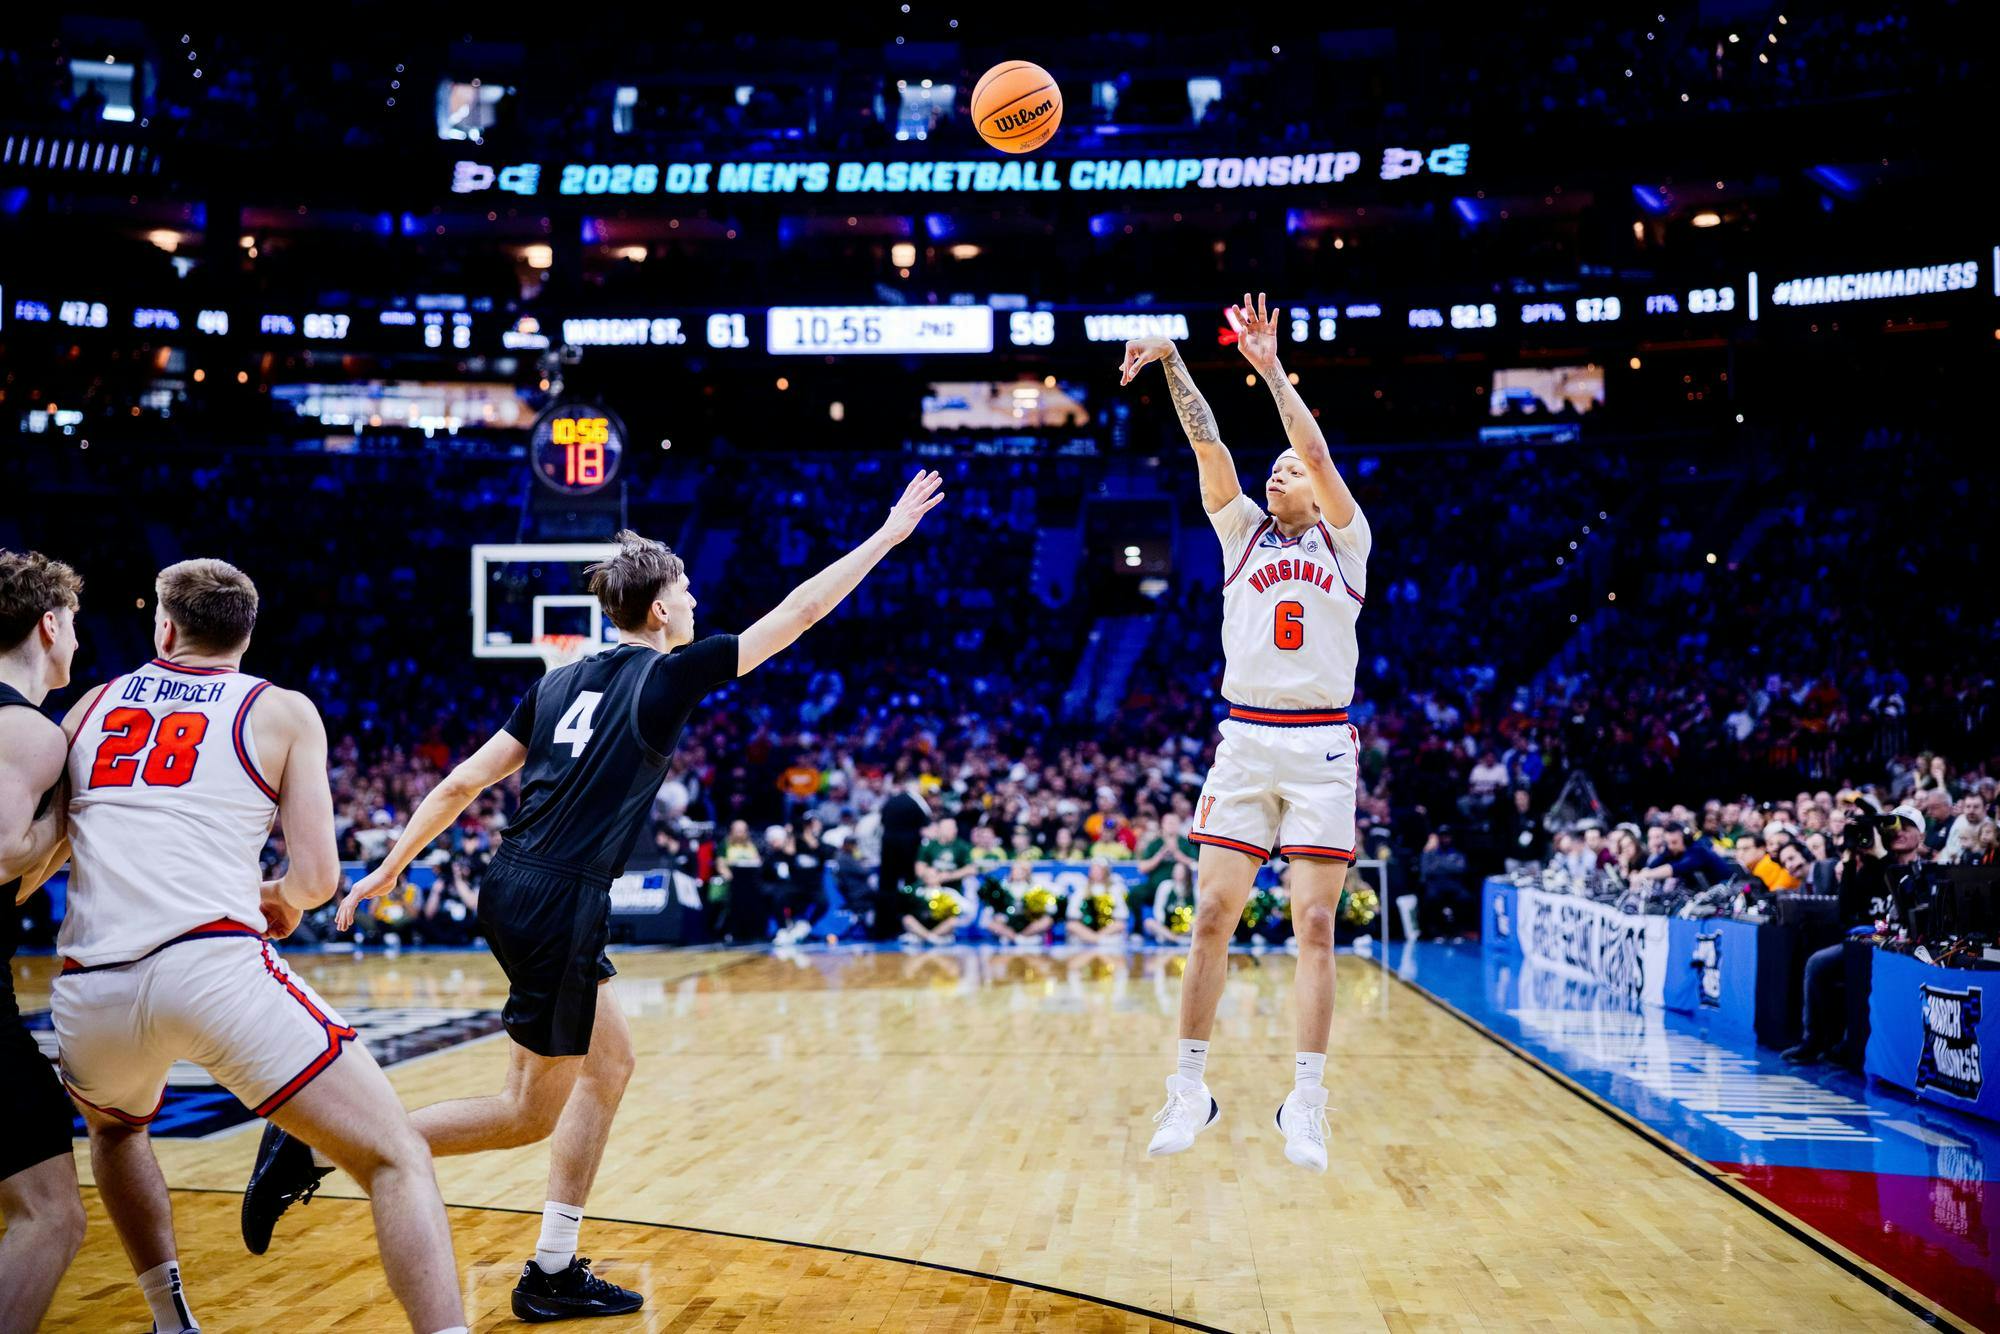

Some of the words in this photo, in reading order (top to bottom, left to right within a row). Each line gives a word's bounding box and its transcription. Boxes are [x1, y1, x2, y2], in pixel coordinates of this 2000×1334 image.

[994, 100, 1053, 133] Wilson
[560, 164, 659, 194] 2026
[717, 162, 830, 192] MEN'S
[836, 161, 1061, 192] BASKETBALL
[1069, 151, 1361, 190] CHAMPIONSHIP
[1772, 261, 1978, 306] #MARCHMADNESS
[650, 318, 686, 345] ST.
[707, 310, 749, 348] 61
[793, 316, 882, 345] 10:56
[1010, 311, 1055, 346] 58
[1084, 314, 1189, 341] VIRGINIA
[566, 443, 604, 485] 18
[1248, 559, 1334, 594] VIRGINIA
[1273, 600, 1304, 651] 6
[121, 675, 155, 702] DE
[553, 690, 604, 758] 4
[88, 706, 210, 790] 28
[1928, 994, 1962, 1039] MARCH
[1933, 1036, 1981, 1083] MADNESS
